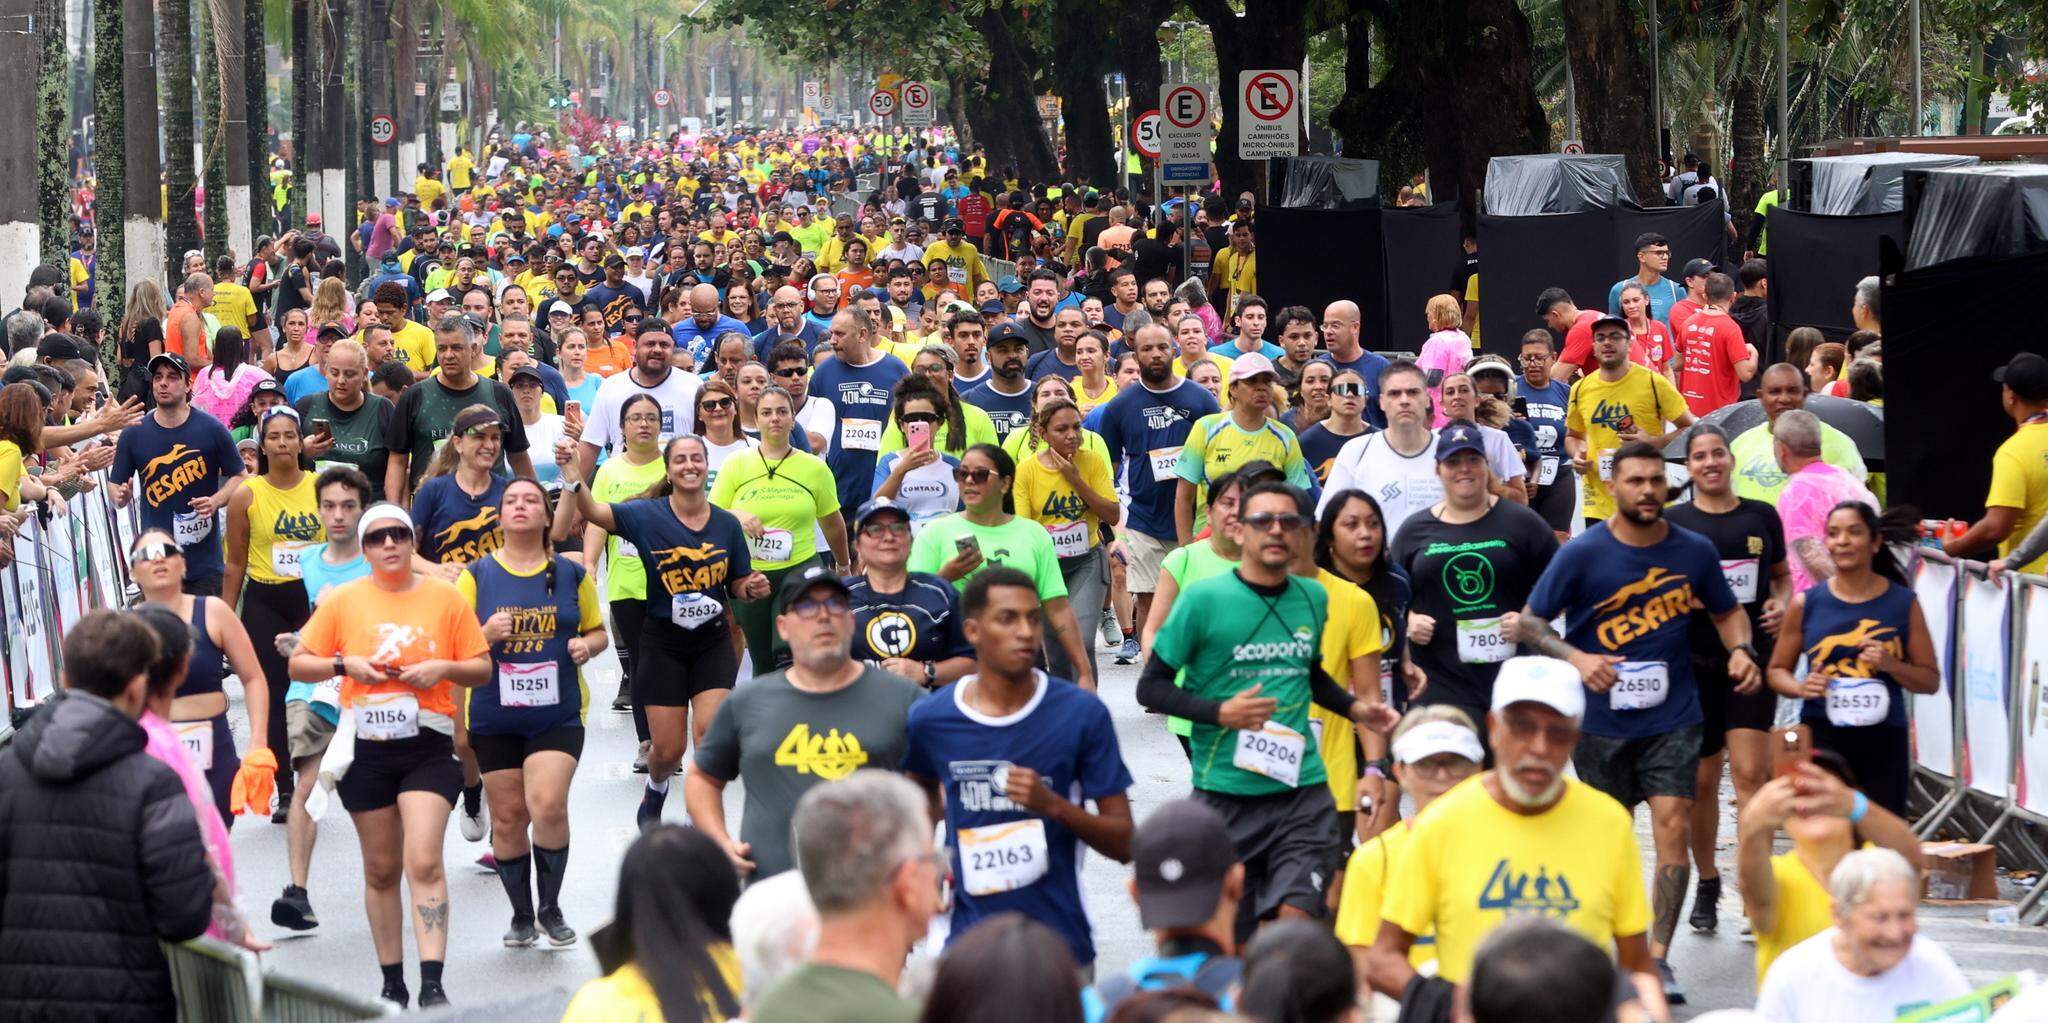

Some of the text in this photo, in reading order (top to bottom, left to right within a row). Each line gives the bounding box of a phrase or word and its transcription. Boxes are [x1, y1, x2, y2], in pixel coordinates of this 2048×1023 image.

[874, 96, 891, 108] 50
[1178, 95, 1192, 118] E
[373, 121, 391, 134] 50
[1255, 123, 1282, 131] ÔNIBUS
[1247, 131, 1290, 140] CAMINHÕES
[846, 429, 877, 440] 22043
[145, 456, 207, 508] CESARI
[180, 519, 209, 534] 26474
[679, 603, 717, 618] 25632
[502, 640, 544, 654] 2026
[511, 678, 548, 691] 15251
[1618, 679, 1661, 692] 26510
[1832, 695, 1880, 708] 26537
[365, 710, 407, 724] 21156
[1244, 735, 1297, 765] 20206
[972, 844, 1033, 870] 22163
